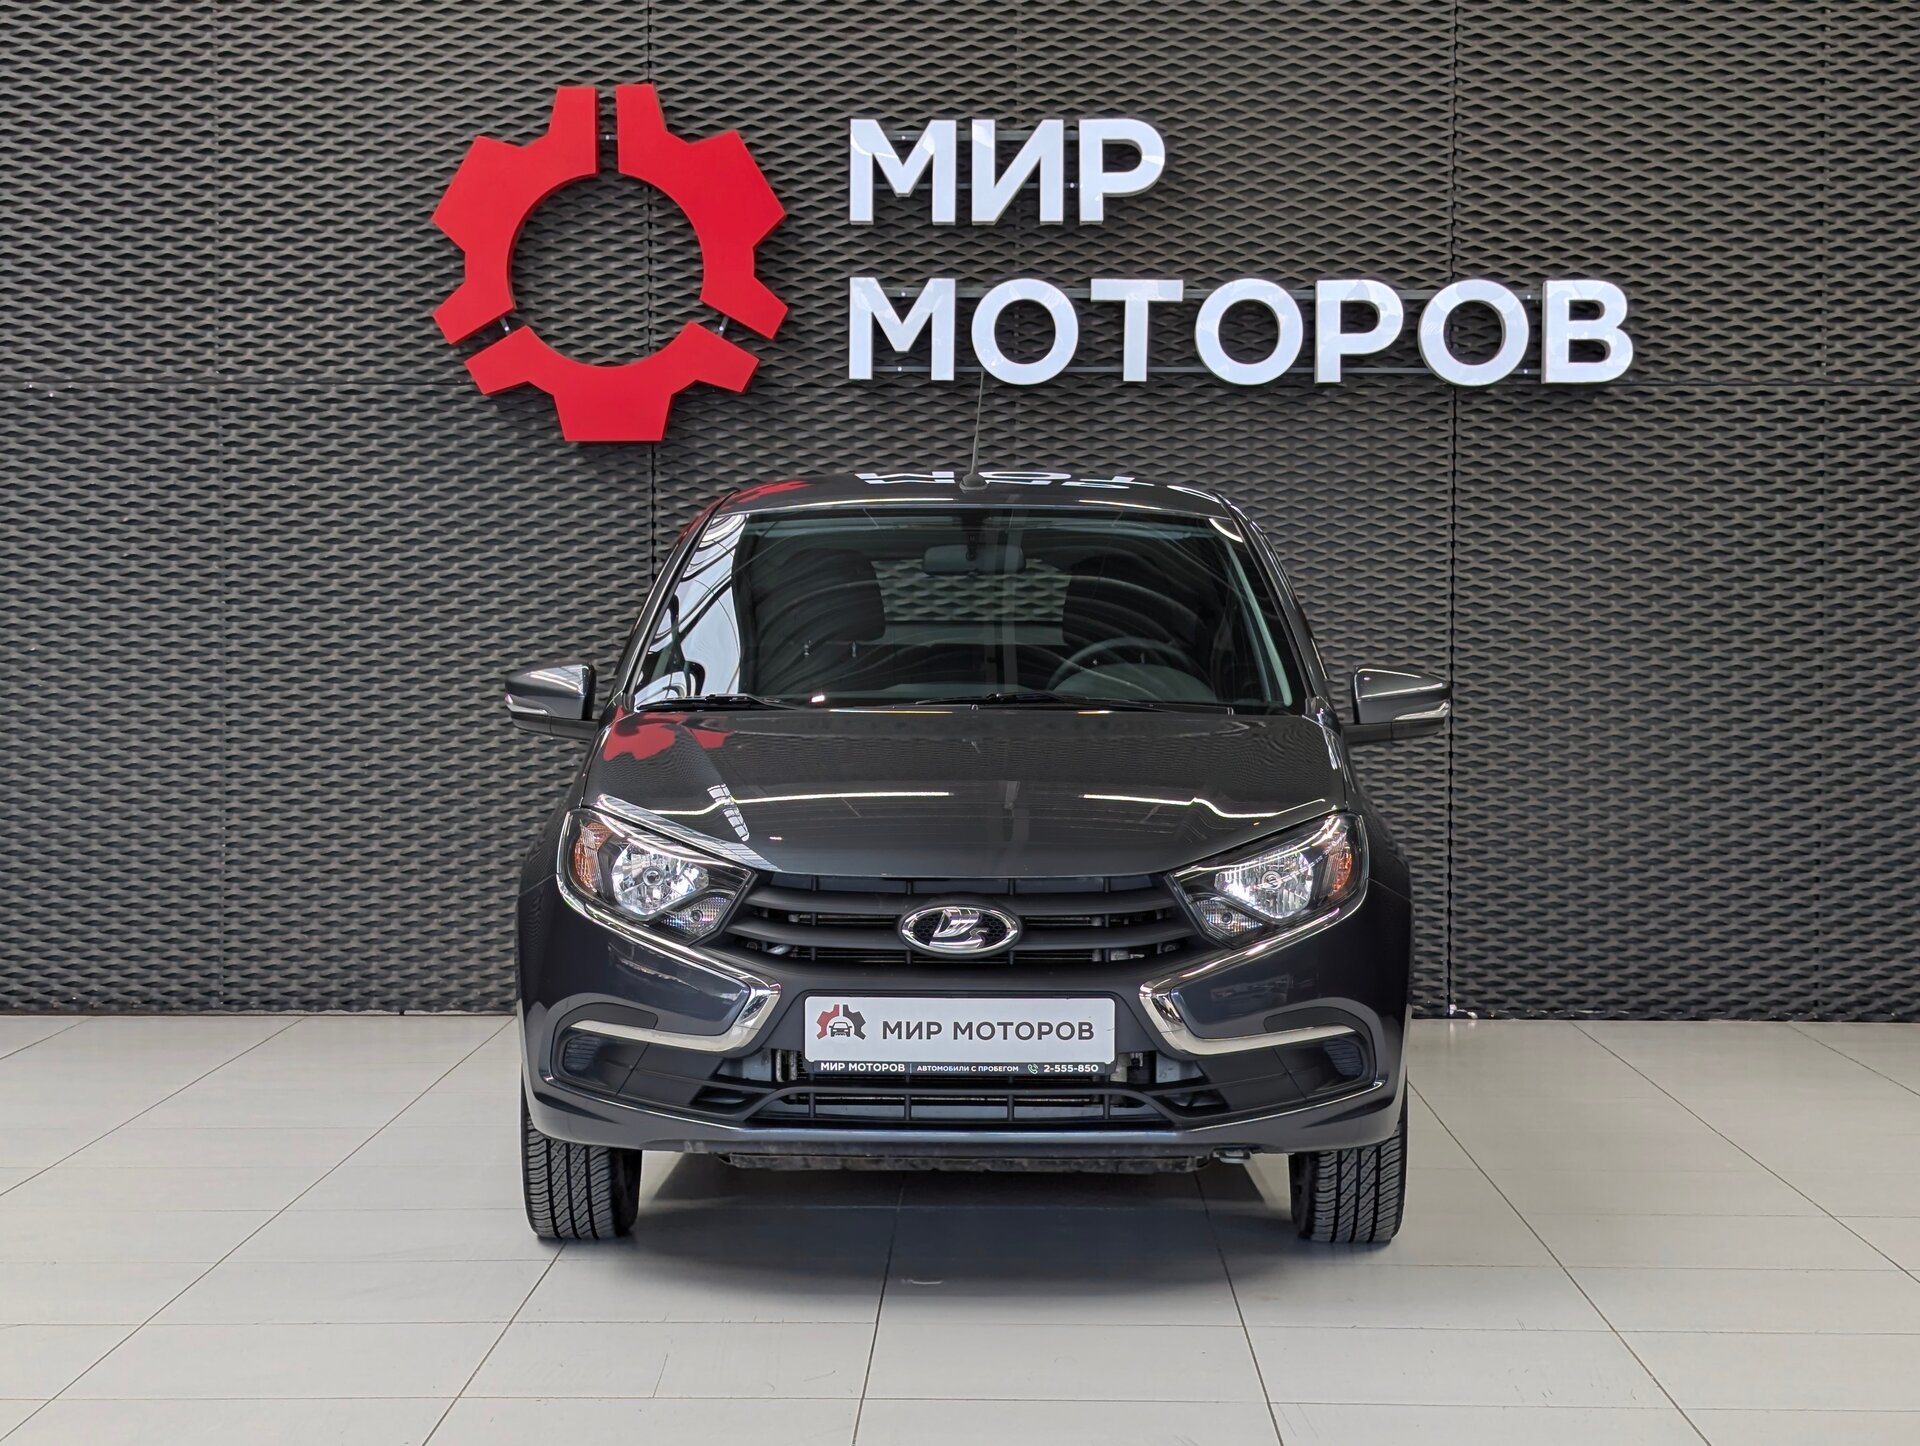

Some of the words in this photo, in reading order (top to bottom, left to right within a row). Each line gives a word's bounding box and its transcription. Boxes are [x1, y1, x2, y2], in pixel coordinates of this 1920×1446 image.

[849, 118, 1166, 224] МИР
[849, 276, 1634, 386] МОТОРОВ
[881, 1020, 943, 1041] МИР
[953, 1021, 1095, 1041] МОТОРОВ
[820, 1062, 846, 1072] МИР
[848, 1062, 906, 1073] МОТОРОВ
[916, 1065, 970, 1073] АВТОМОБИЛИ
[971, 1065, 977, 1073] С
[978, 1065, 1019, 1073] ПРОБЕГОМ
[1043, 1064, 1099, 1073] 2-555-850
